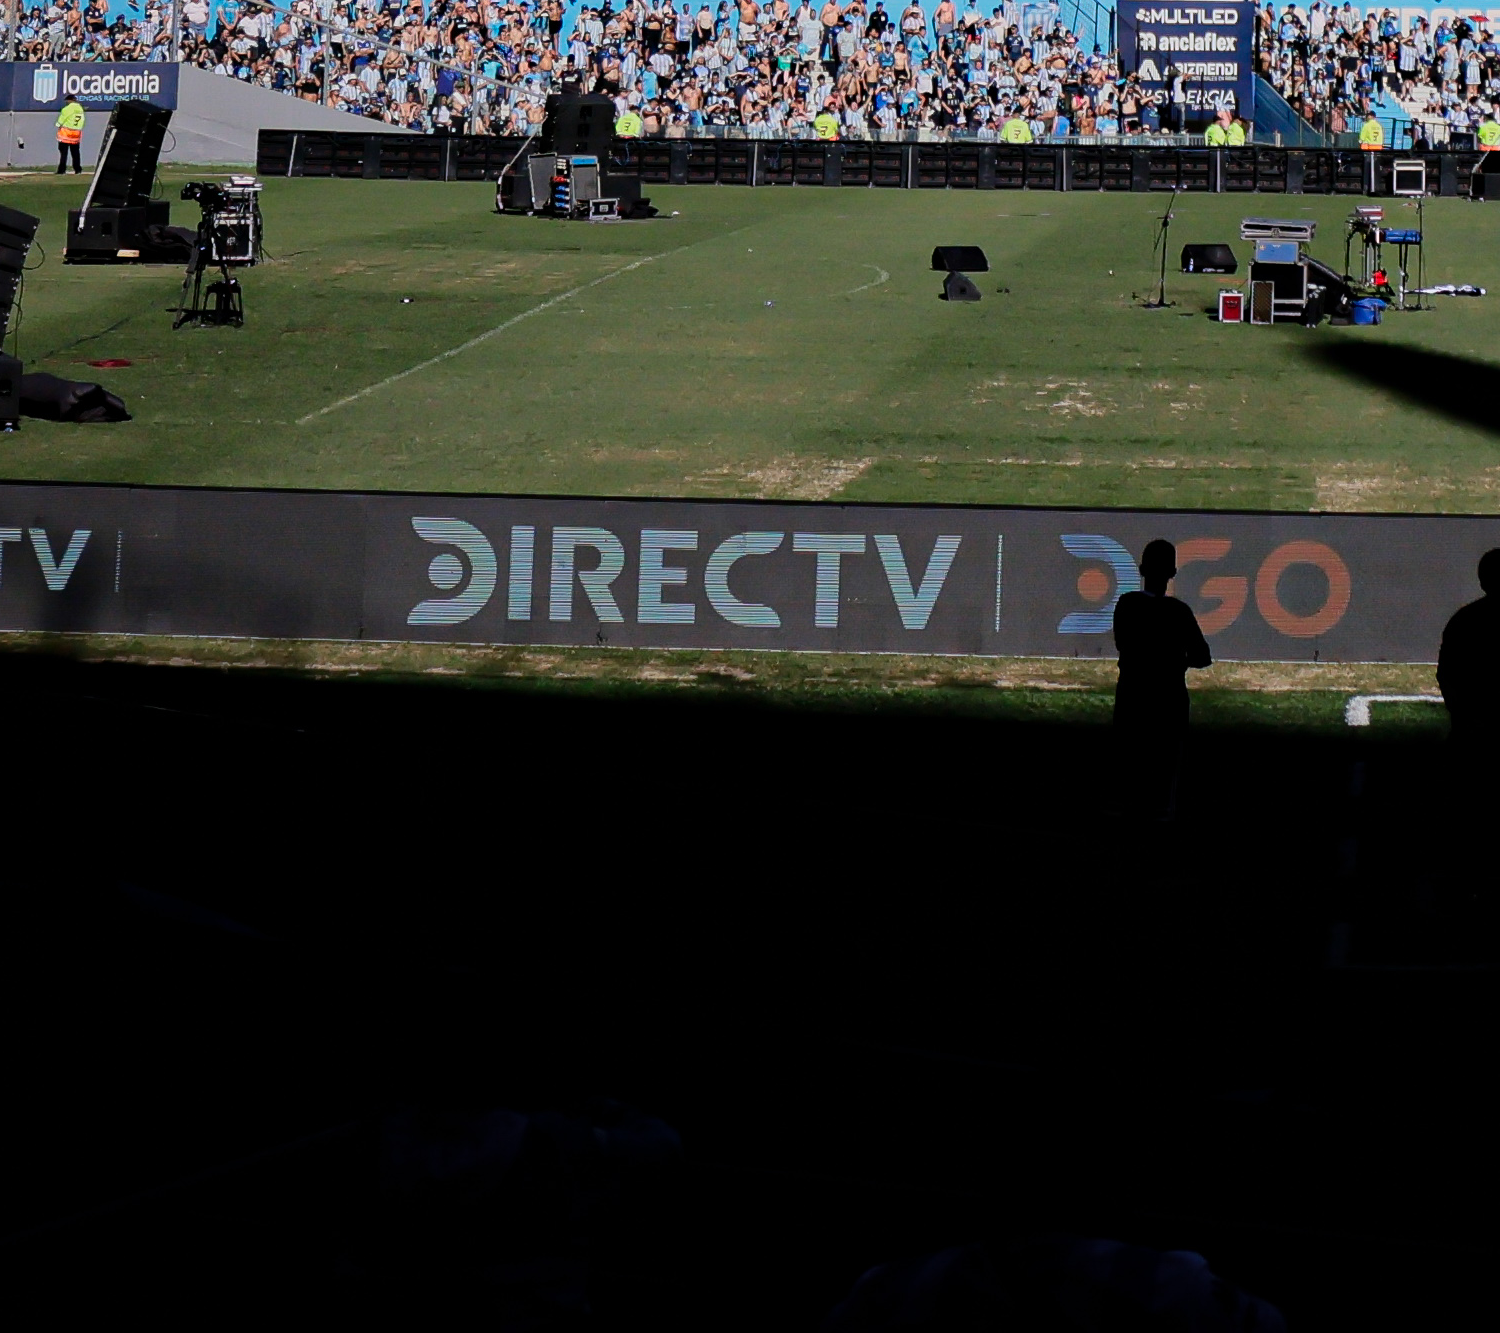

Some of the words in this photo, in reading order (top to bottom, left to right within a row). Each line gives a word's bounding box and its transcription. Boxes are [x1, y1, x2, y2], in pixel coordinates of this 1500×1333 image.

[1151, 8, 1238, 25] MULTILED
[1159, 32, 1237, 52] anclaflex
[63, 69, 160, 95] locademia
[407, 516, 963, 632] DIRECTV
